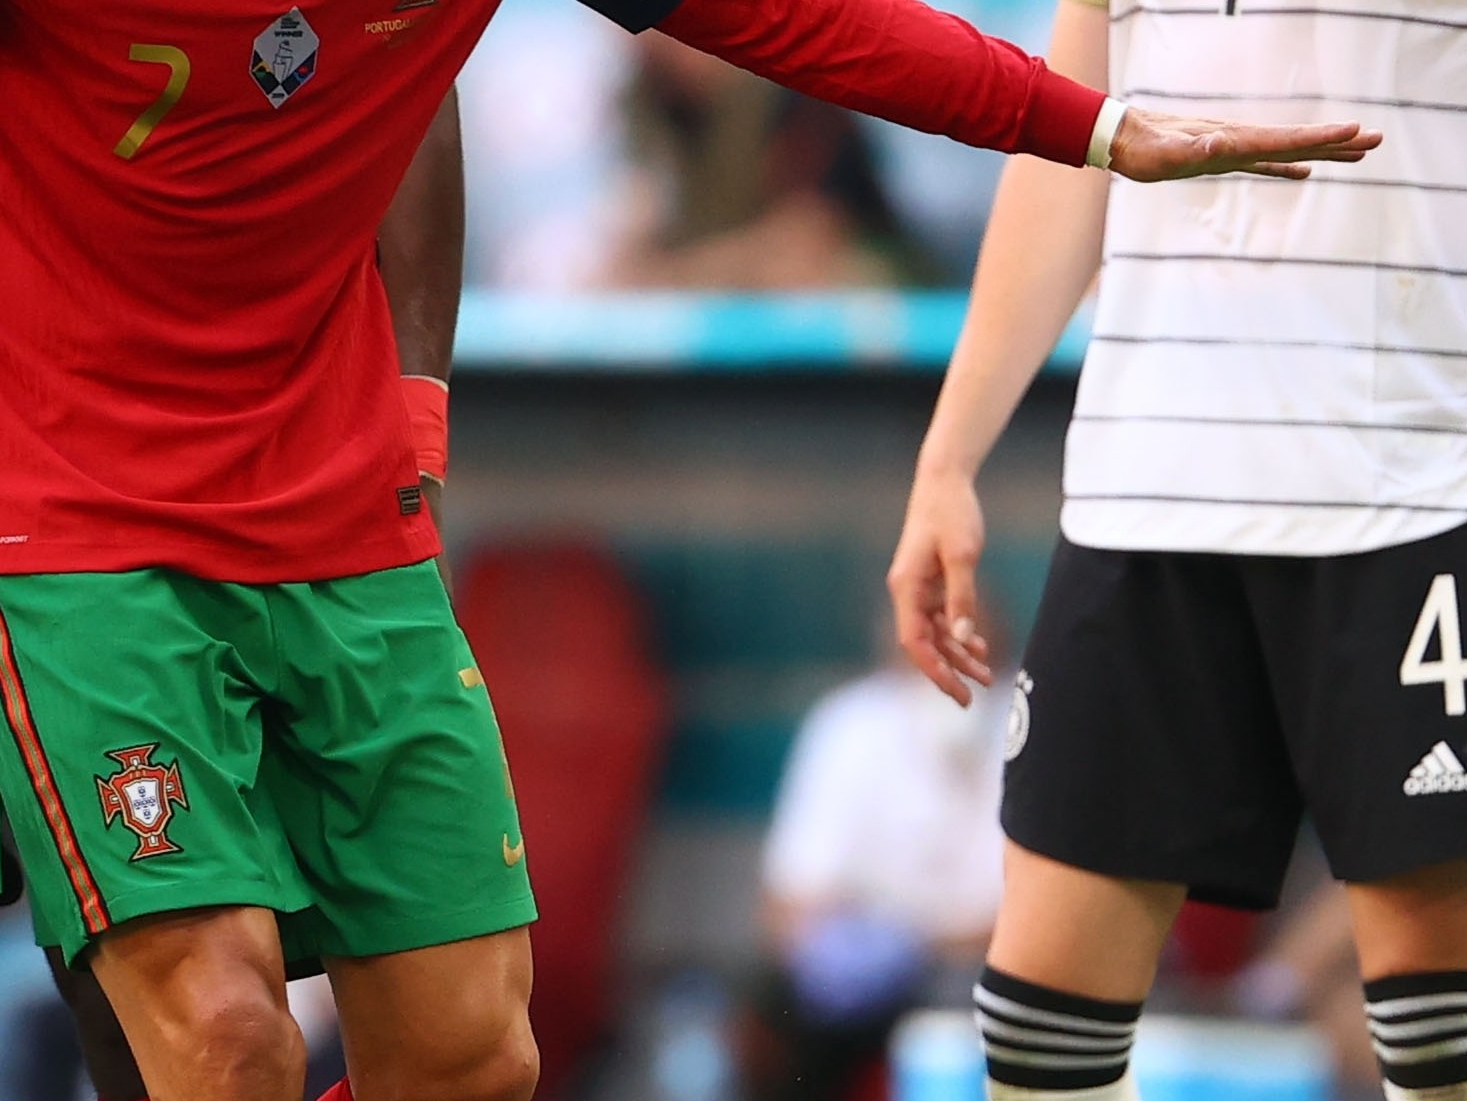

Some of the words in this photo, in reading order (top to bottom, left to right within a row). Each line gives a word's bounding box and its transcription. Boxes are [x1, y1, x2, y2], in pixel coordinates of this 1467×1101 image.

[113, 43, 191, 160] 7
[1400, 573, 1467, 716] 4
[1402, 772, 1467, 796] adida
